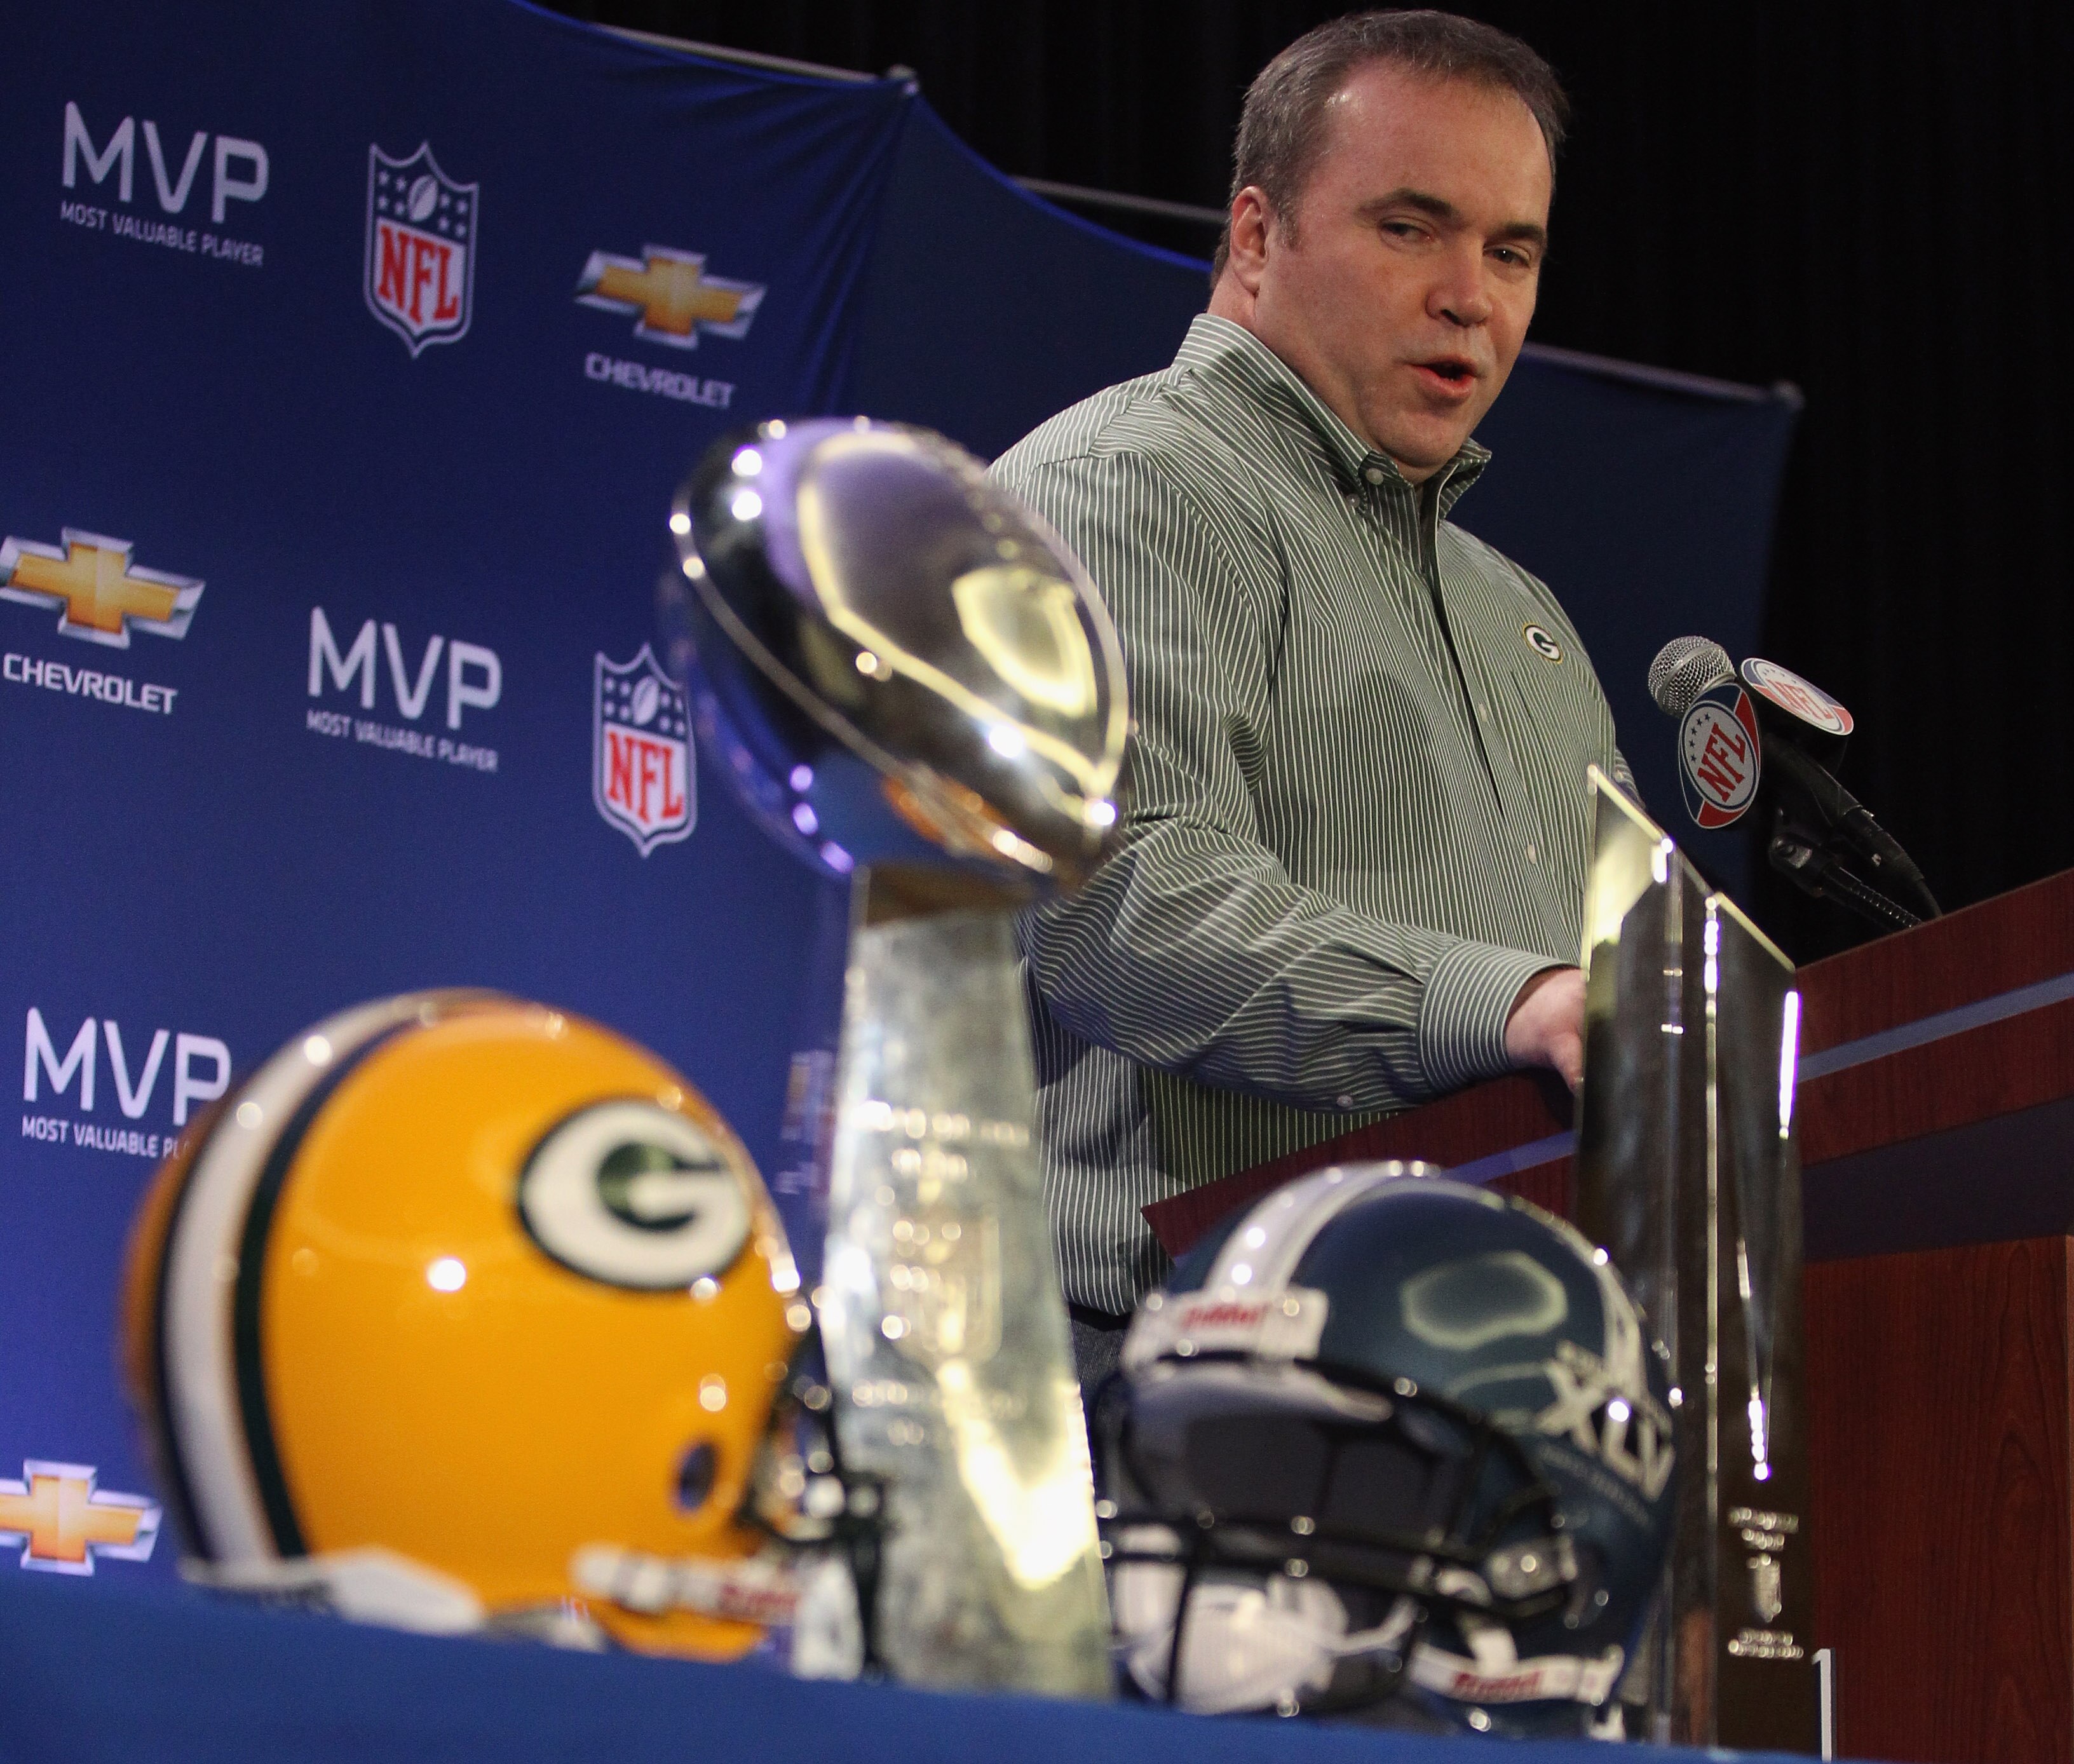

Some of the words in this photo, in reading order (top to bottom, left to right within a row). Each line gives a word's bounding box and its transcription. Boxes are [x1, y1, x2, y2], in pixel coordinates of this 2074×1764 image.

[62, 100, 269, 224] MVP
[60, 200, 108, 230] MOST
[112, 212, 198, 253] VALUABLE
[201, 233, 264, 268] PLAYER
[377, 225, 461, 325] NFL
[584, 351, 736, 410] CHEVROLET
[3, 652, 179, 715] CHEVROLET
[308, 606, 503, 730] MVP
[1764, 677, 1834, 721] NFL
[306, 709, 351, 738] MOST
[354, 719, 436, 759] VALUABLE
[437, 738, 499, 773] PLAYER
[607, 731, 684, 825] NFL
[1697, 721, 1746, 803] NFL
[23, 1007, 233, 1127] MVP
[21, 1114, 69, 1143] MOST
[73, 1122, 159, 1159] VALUABLE
